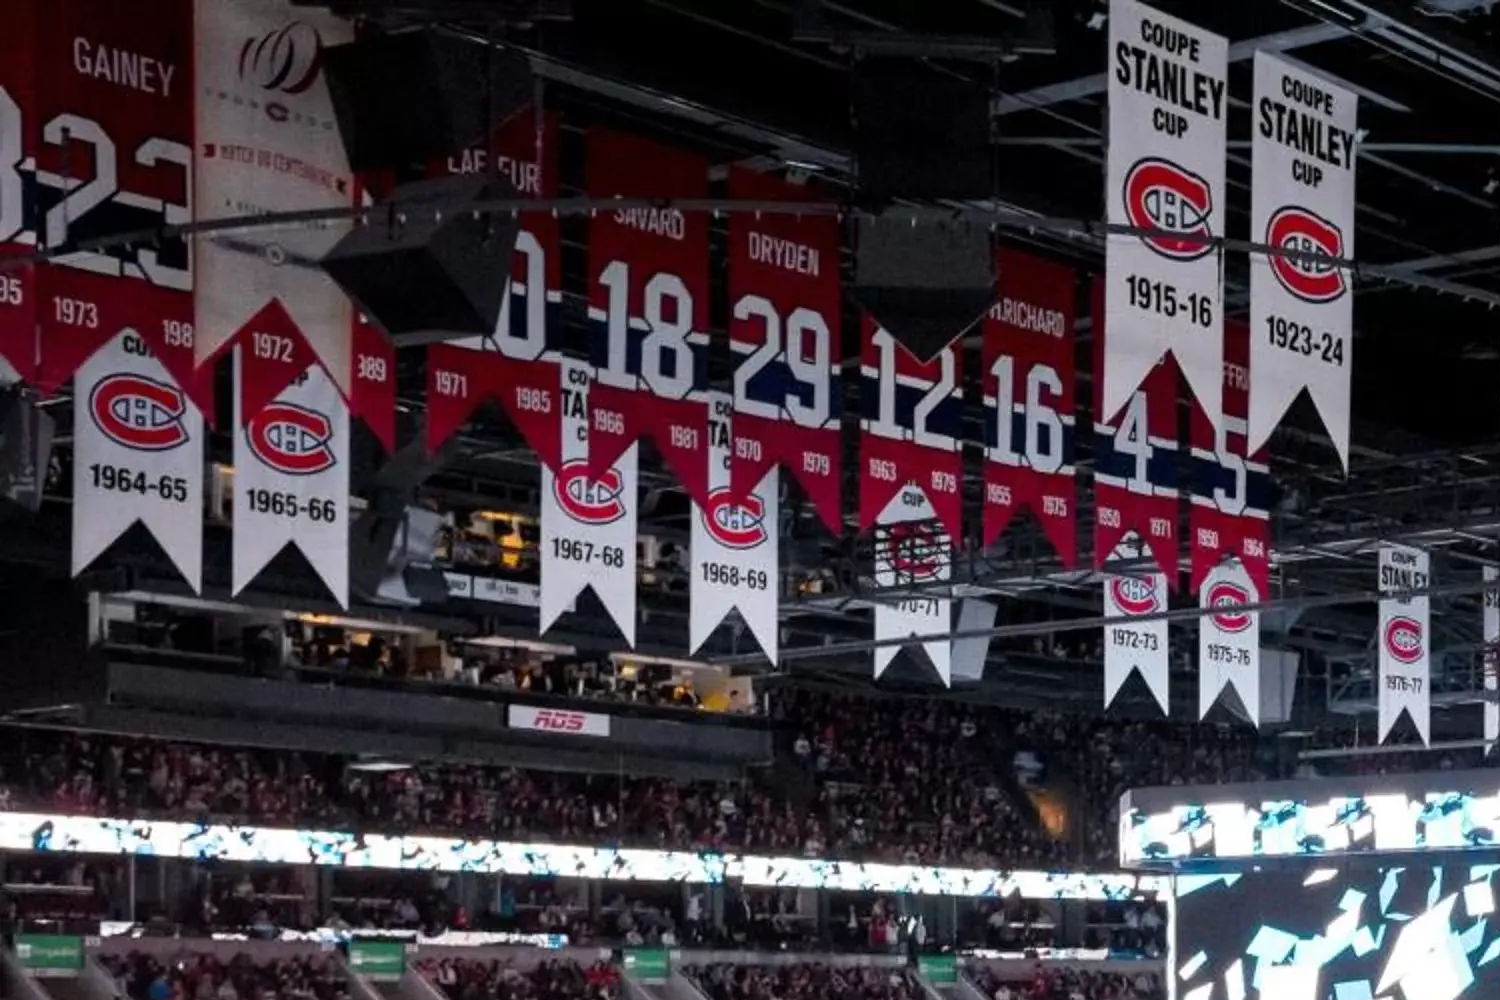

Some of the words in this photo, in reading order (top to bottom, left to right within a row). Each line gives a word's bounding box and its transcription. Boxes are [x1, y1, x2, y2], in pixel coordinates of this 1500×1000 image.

[1141, 19, 1200, 62] COUPE
[73, 35, 177, 97] GAINEY
[1116, 41, 1225, 120] STANLEY
[1281, 75, 1334, 115] COUPE
[1152, 107, 1189, 138] CUP
[1259, 96, 1353, 170] STANLEY
[1291, 158, 1324, 189] CUP
[748, 231, 820, 277] DRYDEN
[53, 296, 98, 328] 1973
[1126, 274, 1213, 328] 1915-16
[599, 259, 696, 399] 18
[1265, 315, 1344, 366] 1923-24
[252, 332, 294, 363] 1972
[733, 293, 830, 429] 29
[435, 369, 468, 400] 1971
[515, 385, 552, 415] 1985
[592, 408, 625, 436] 1966
[990, 354, 1063, 474] 16
[1113, 389, 1154, 496] 4
[89, 464, 188, 502] 1964-65
[901, 491, 926, 508] CUP
[246, 489, 337, 523] 1965-66
[551, 538, 625, 569] 1967-68
[701, 561, 768, 591] 1968-69
[1112, 628, 1159, 652] 1972-73
[1207, 643, 1251, 667] 1975-76
[1386, 674, 1424, 694] 1976-77
